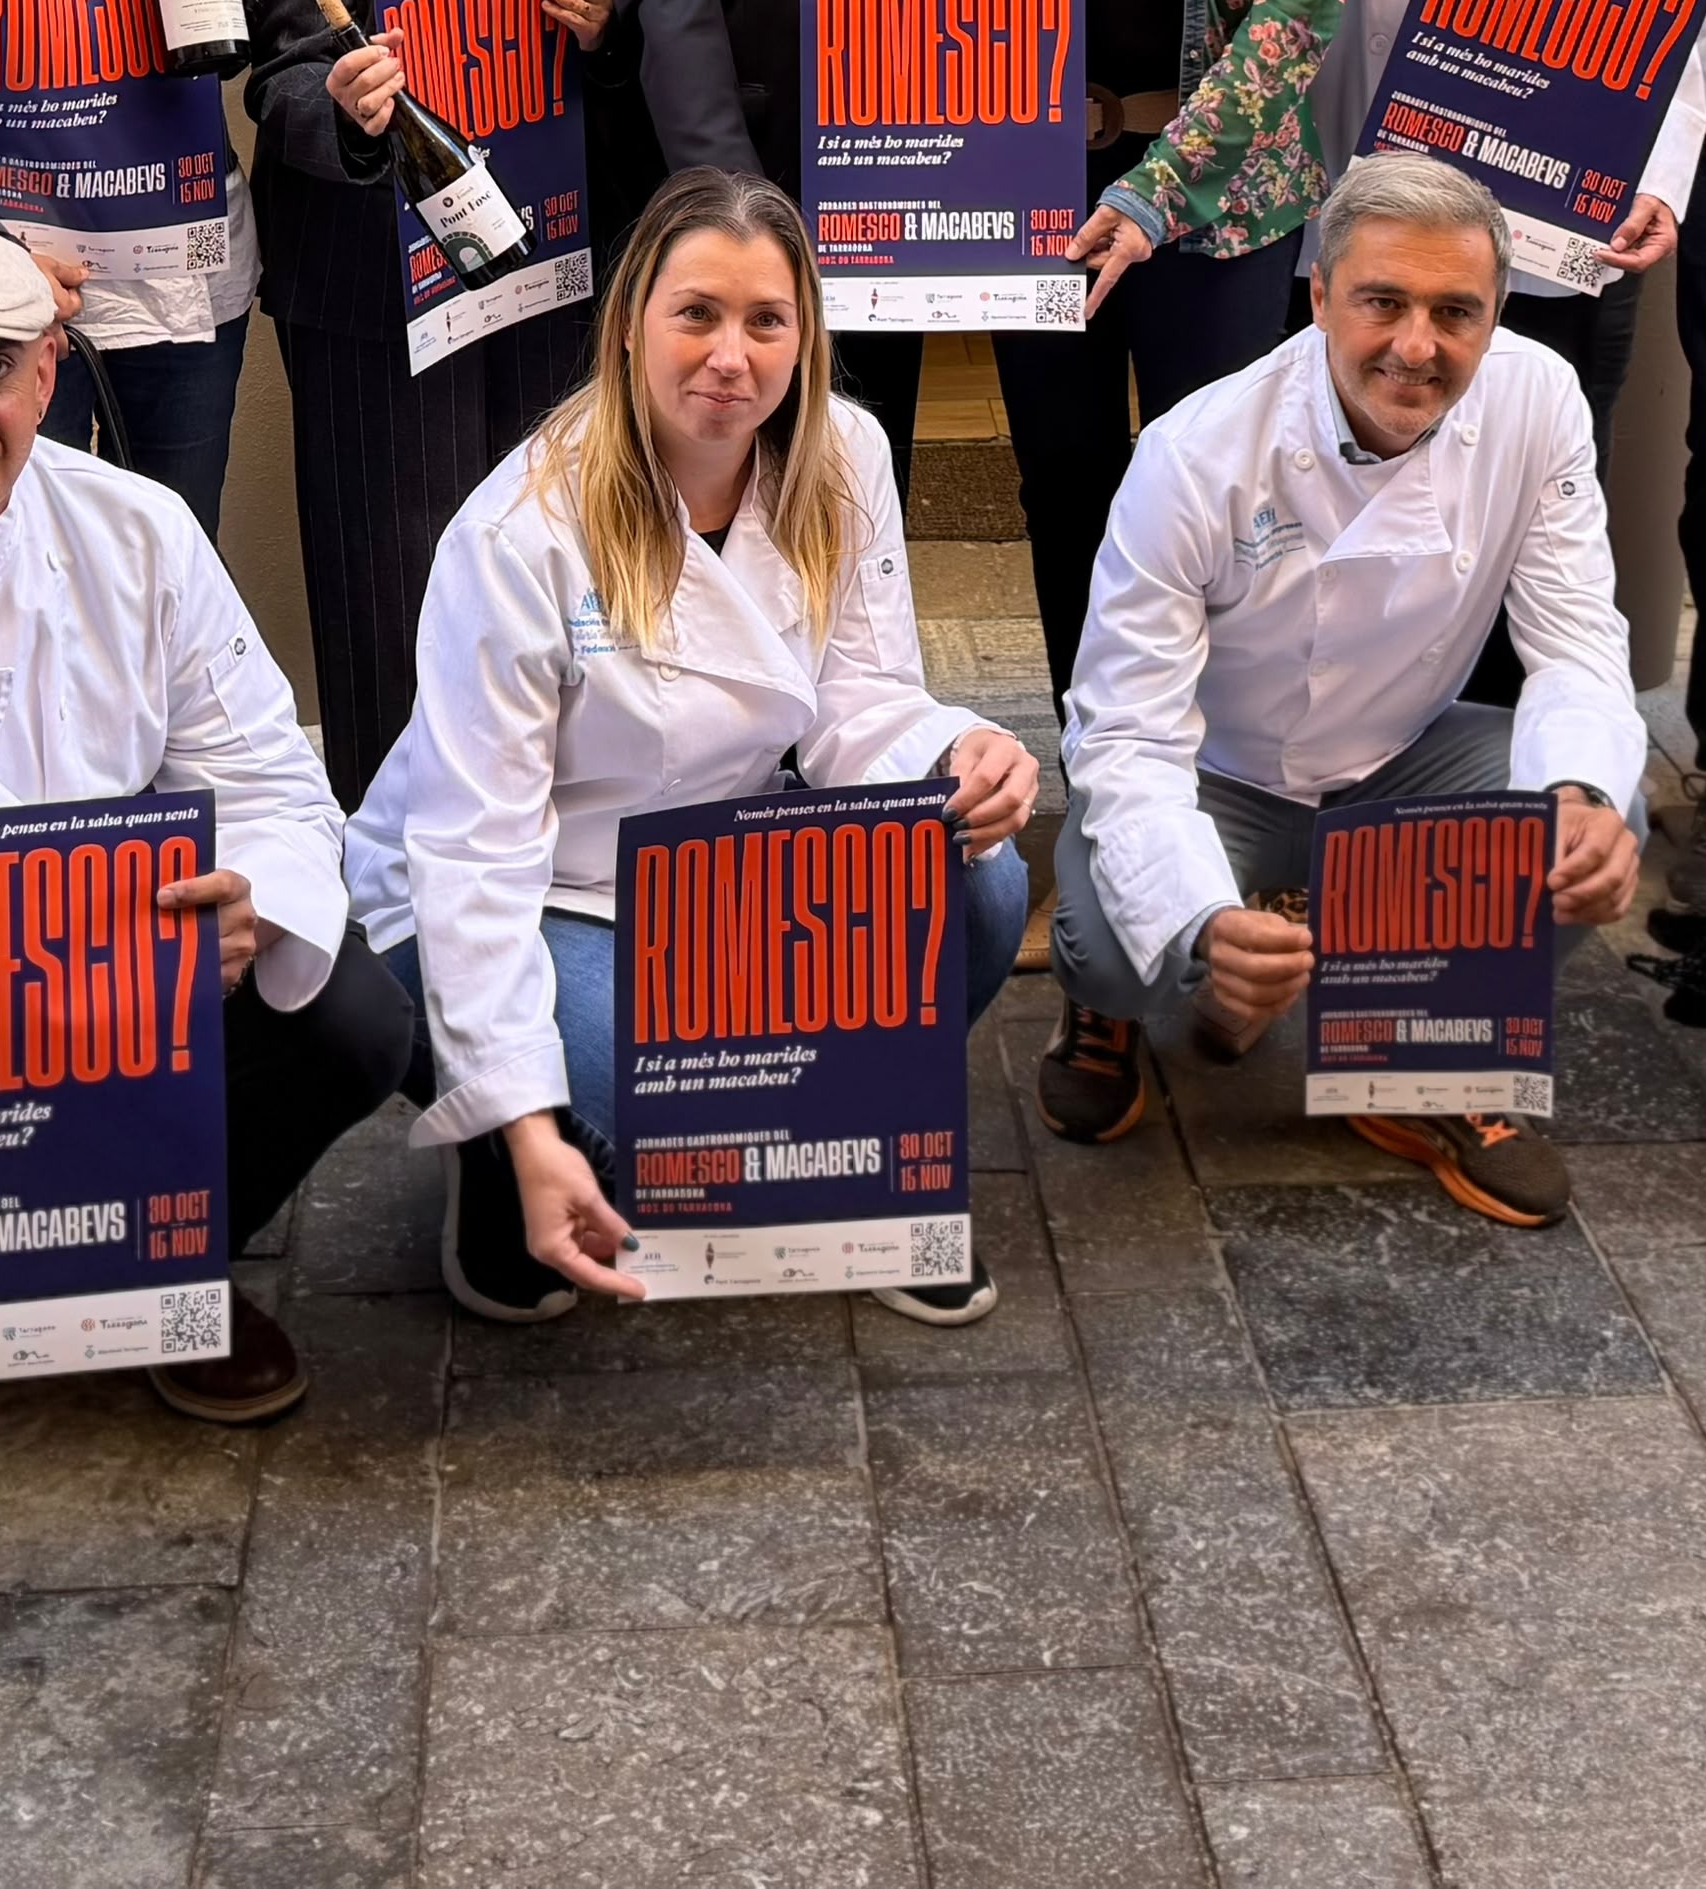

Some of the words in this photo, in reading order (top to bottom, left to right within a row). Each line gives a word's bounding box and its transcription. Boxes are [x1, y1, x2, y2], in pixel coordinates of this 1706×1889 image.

[1382, 101, 1463, 152] ROMESCO
[1463, 129, 1478, 155] &
[1478, 137, 1570, 189] MACABEVS
[56, 171, 70, 198] &
[74, 159, 166, 199] MACABEVS
[818, 213, 900, 242] ROMESCO
[904, 214, 918, 240] &
[921, 211, 1014, 240] MACABEVS
[1050, 209, 1075, 230] OCT
[1047, 235, 1075, 256] NOV
[1, 822, 48, 839] penses
[50, 820, 66, 831] en
[70, 816, 84, 830] la
[87, 813, 123, 828] salsa
[126, 809, 162, 827] quan
[165, 808, 199, 821] sents
[1321, 817, 1545, 954] ROMESCO?
[635, 819, 946, 1043] ROMESCO?
[1321, 1021, 1393, 1044] ROMESCO
[1396, 1020, 1407, 1043] &
[1411, 1019, 1492, 1043] MACABEVS
[922, 1132, 954, 1158] OCT
[635, 1148, 740, 1186] ROMESCO
[745, 1150, 762, 1180] &
[765, 1138, 881, 1179] MACABEVS
[920, 1164, 952, 1191] NOV
[175, 1191, 209, 1221] OCT
[172, 1225, 207, 1256] NOV
